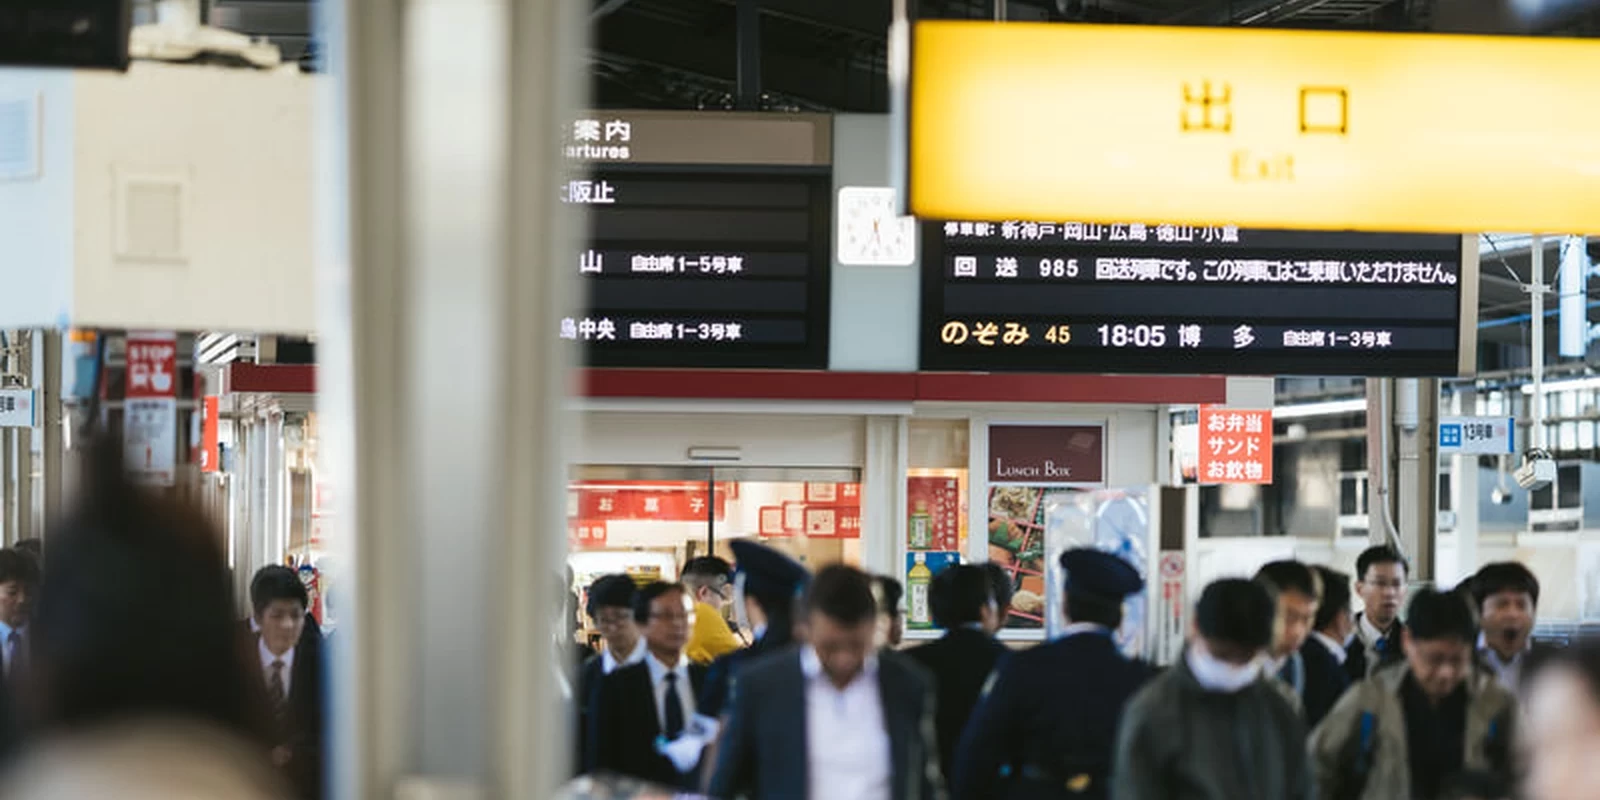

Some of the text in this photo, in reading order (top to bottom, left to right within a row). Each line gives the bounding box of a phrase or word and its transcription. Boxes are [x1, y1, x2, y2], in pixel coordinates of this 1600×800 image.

[1180, 79, 1348, 134] 出口
[561, 119, 631, 142] 案内
[561, 144, 630, 159] artures
[1231, 151, 1296, 182] Exit
[1039, 258, 1079, 278] 985
[941, 321, 1030, 345] のぞみ
[1044, 325, 1071, 343] 45
[1097, 324, 1166, 347] 18:05
[1207, 413, 1262, 433] お弁当
[1207, 436, 1260, 457] サンド
[1207, 459, 1262, 479] お飲物
